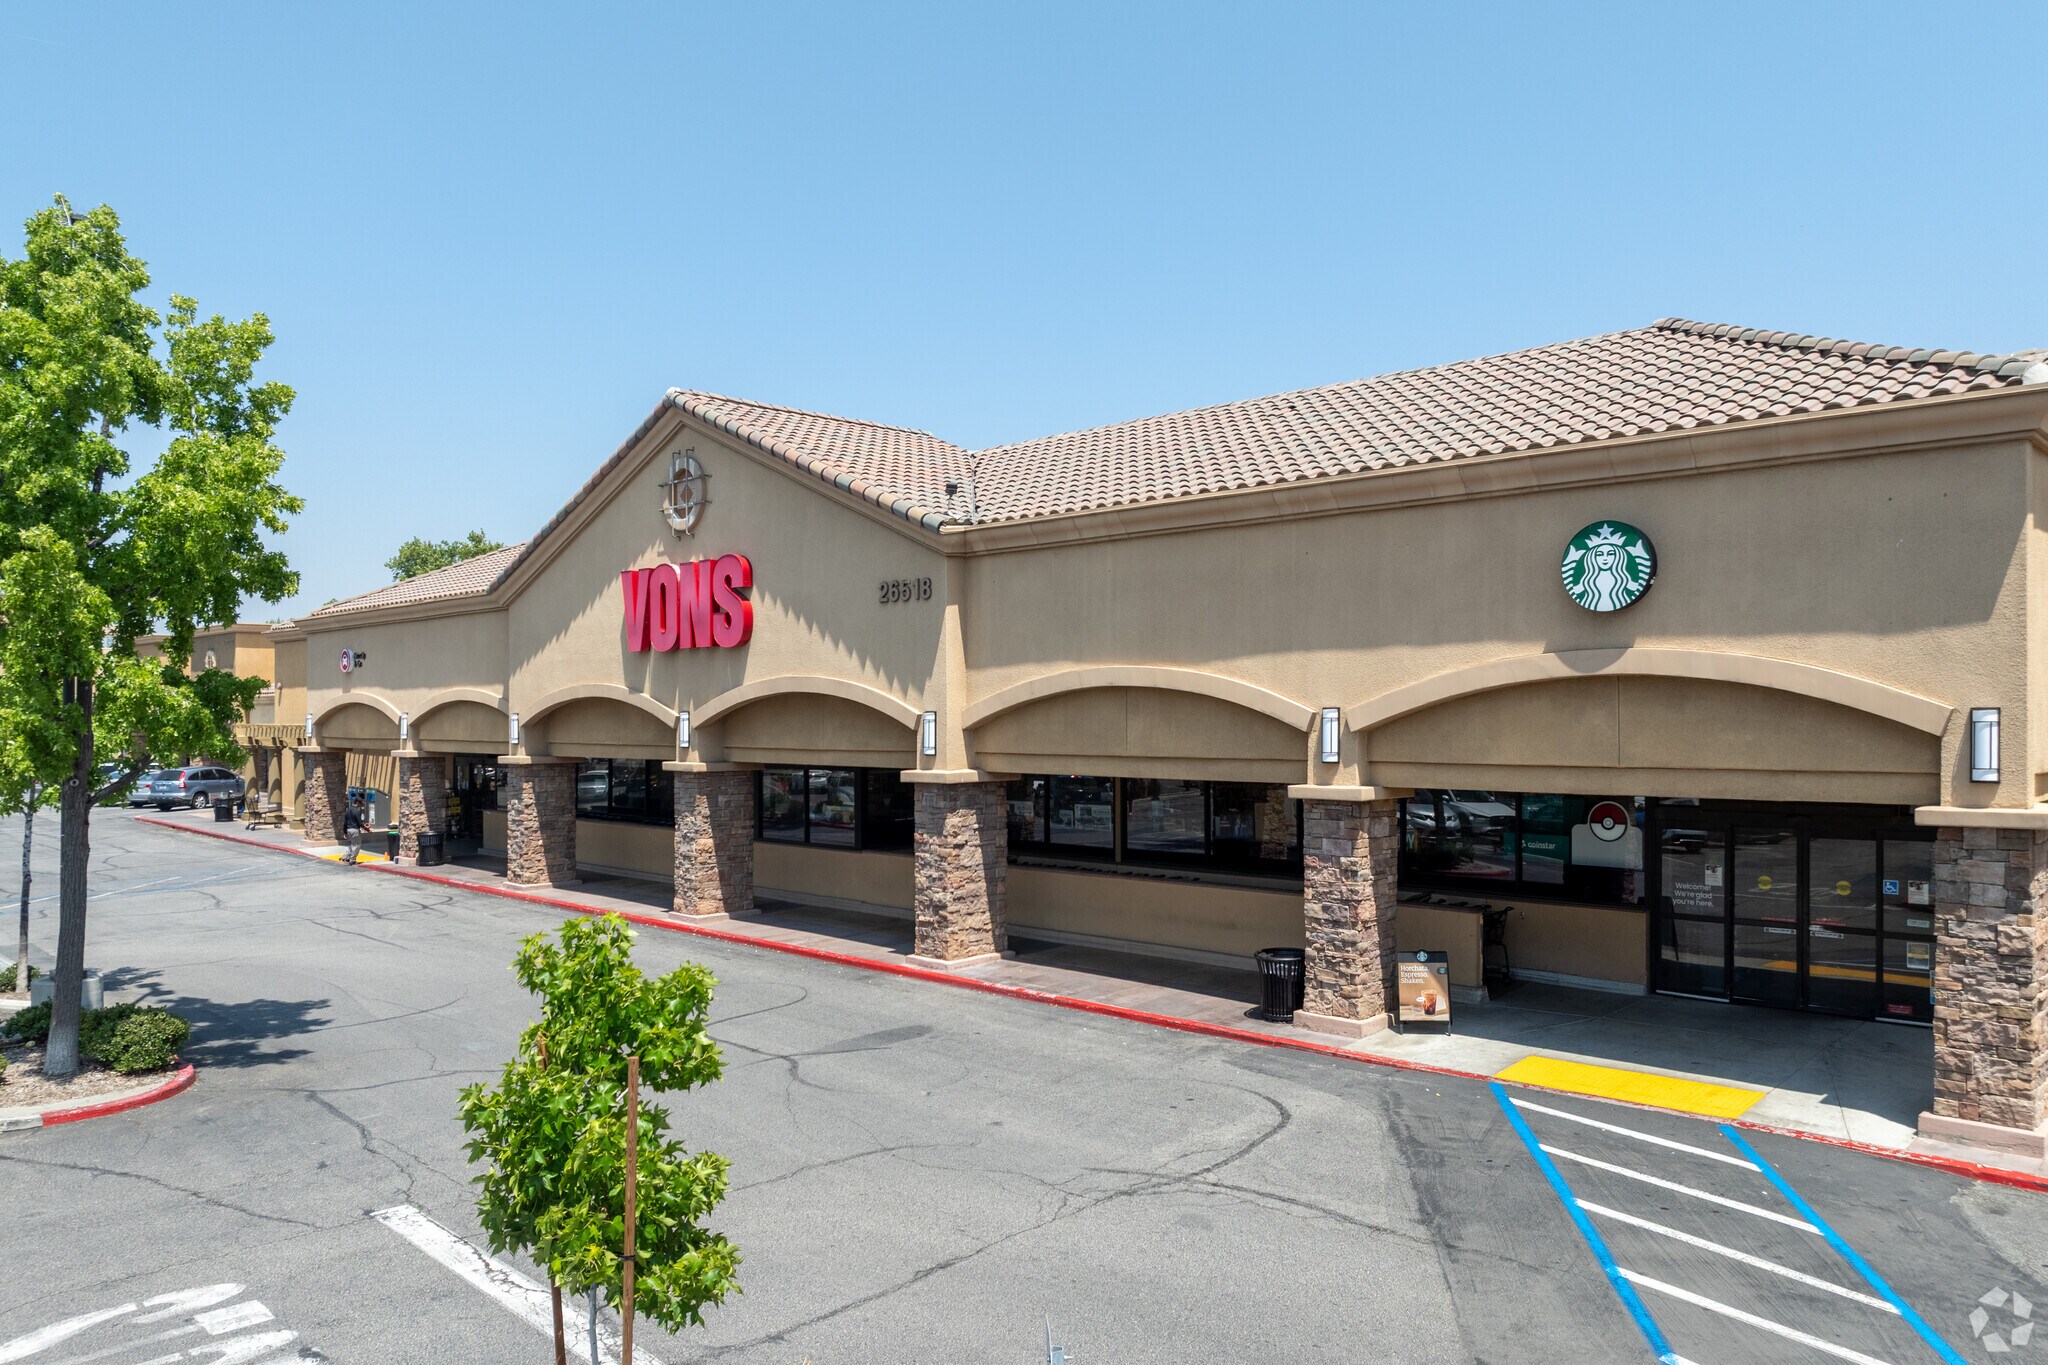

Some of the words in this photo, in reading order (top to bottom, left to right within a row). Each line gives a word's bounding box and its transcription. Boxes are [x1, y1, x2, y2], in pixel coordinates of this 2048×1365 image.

[879, 577, 933, 603] 26518
[621, 553, 753, 652] VONS
[1527, 841, 1556, 850] coinstar
[1675, 882, 1712, 891] Welcome!
[1674, 889, 1695, 898] We're
[1695, 891, 1713, 900] glad
[1672, 898, 1695, 906] you're
[1695, 899, 1714, 907] here.
